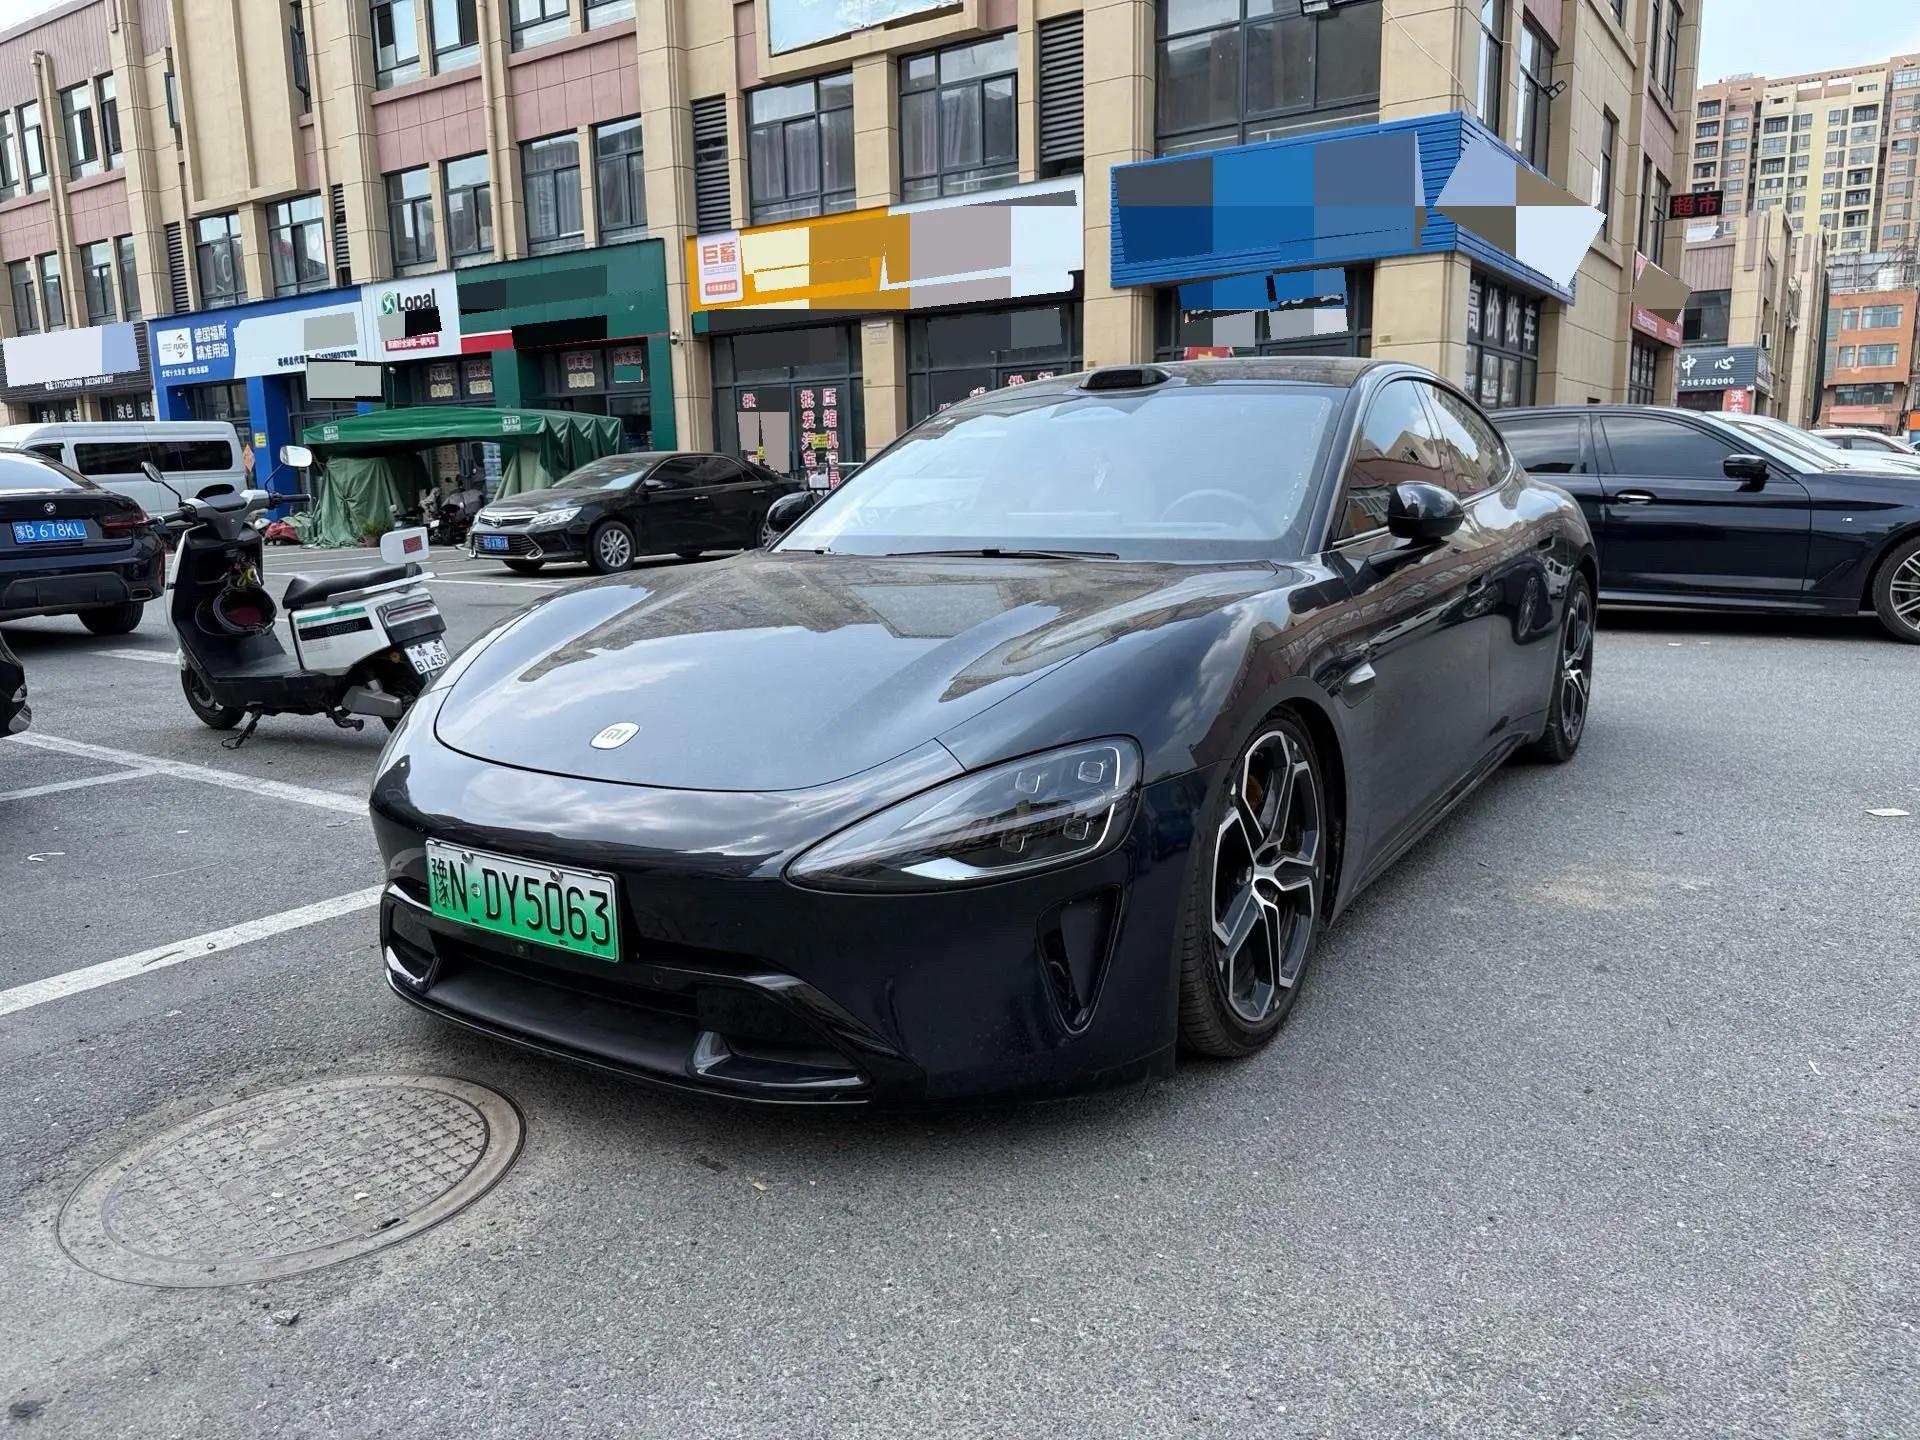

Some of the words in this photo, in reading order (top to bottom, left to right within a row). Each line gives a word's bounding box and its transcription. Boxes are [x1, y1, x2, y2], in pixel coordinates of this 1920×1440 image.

[1673, 194, 1719, 216] 超市
[396, 288, 436, 312] Lopal
[1468, 280, 1537, 350] 高价收车
[1681, 354, 1735, 377] 中心
